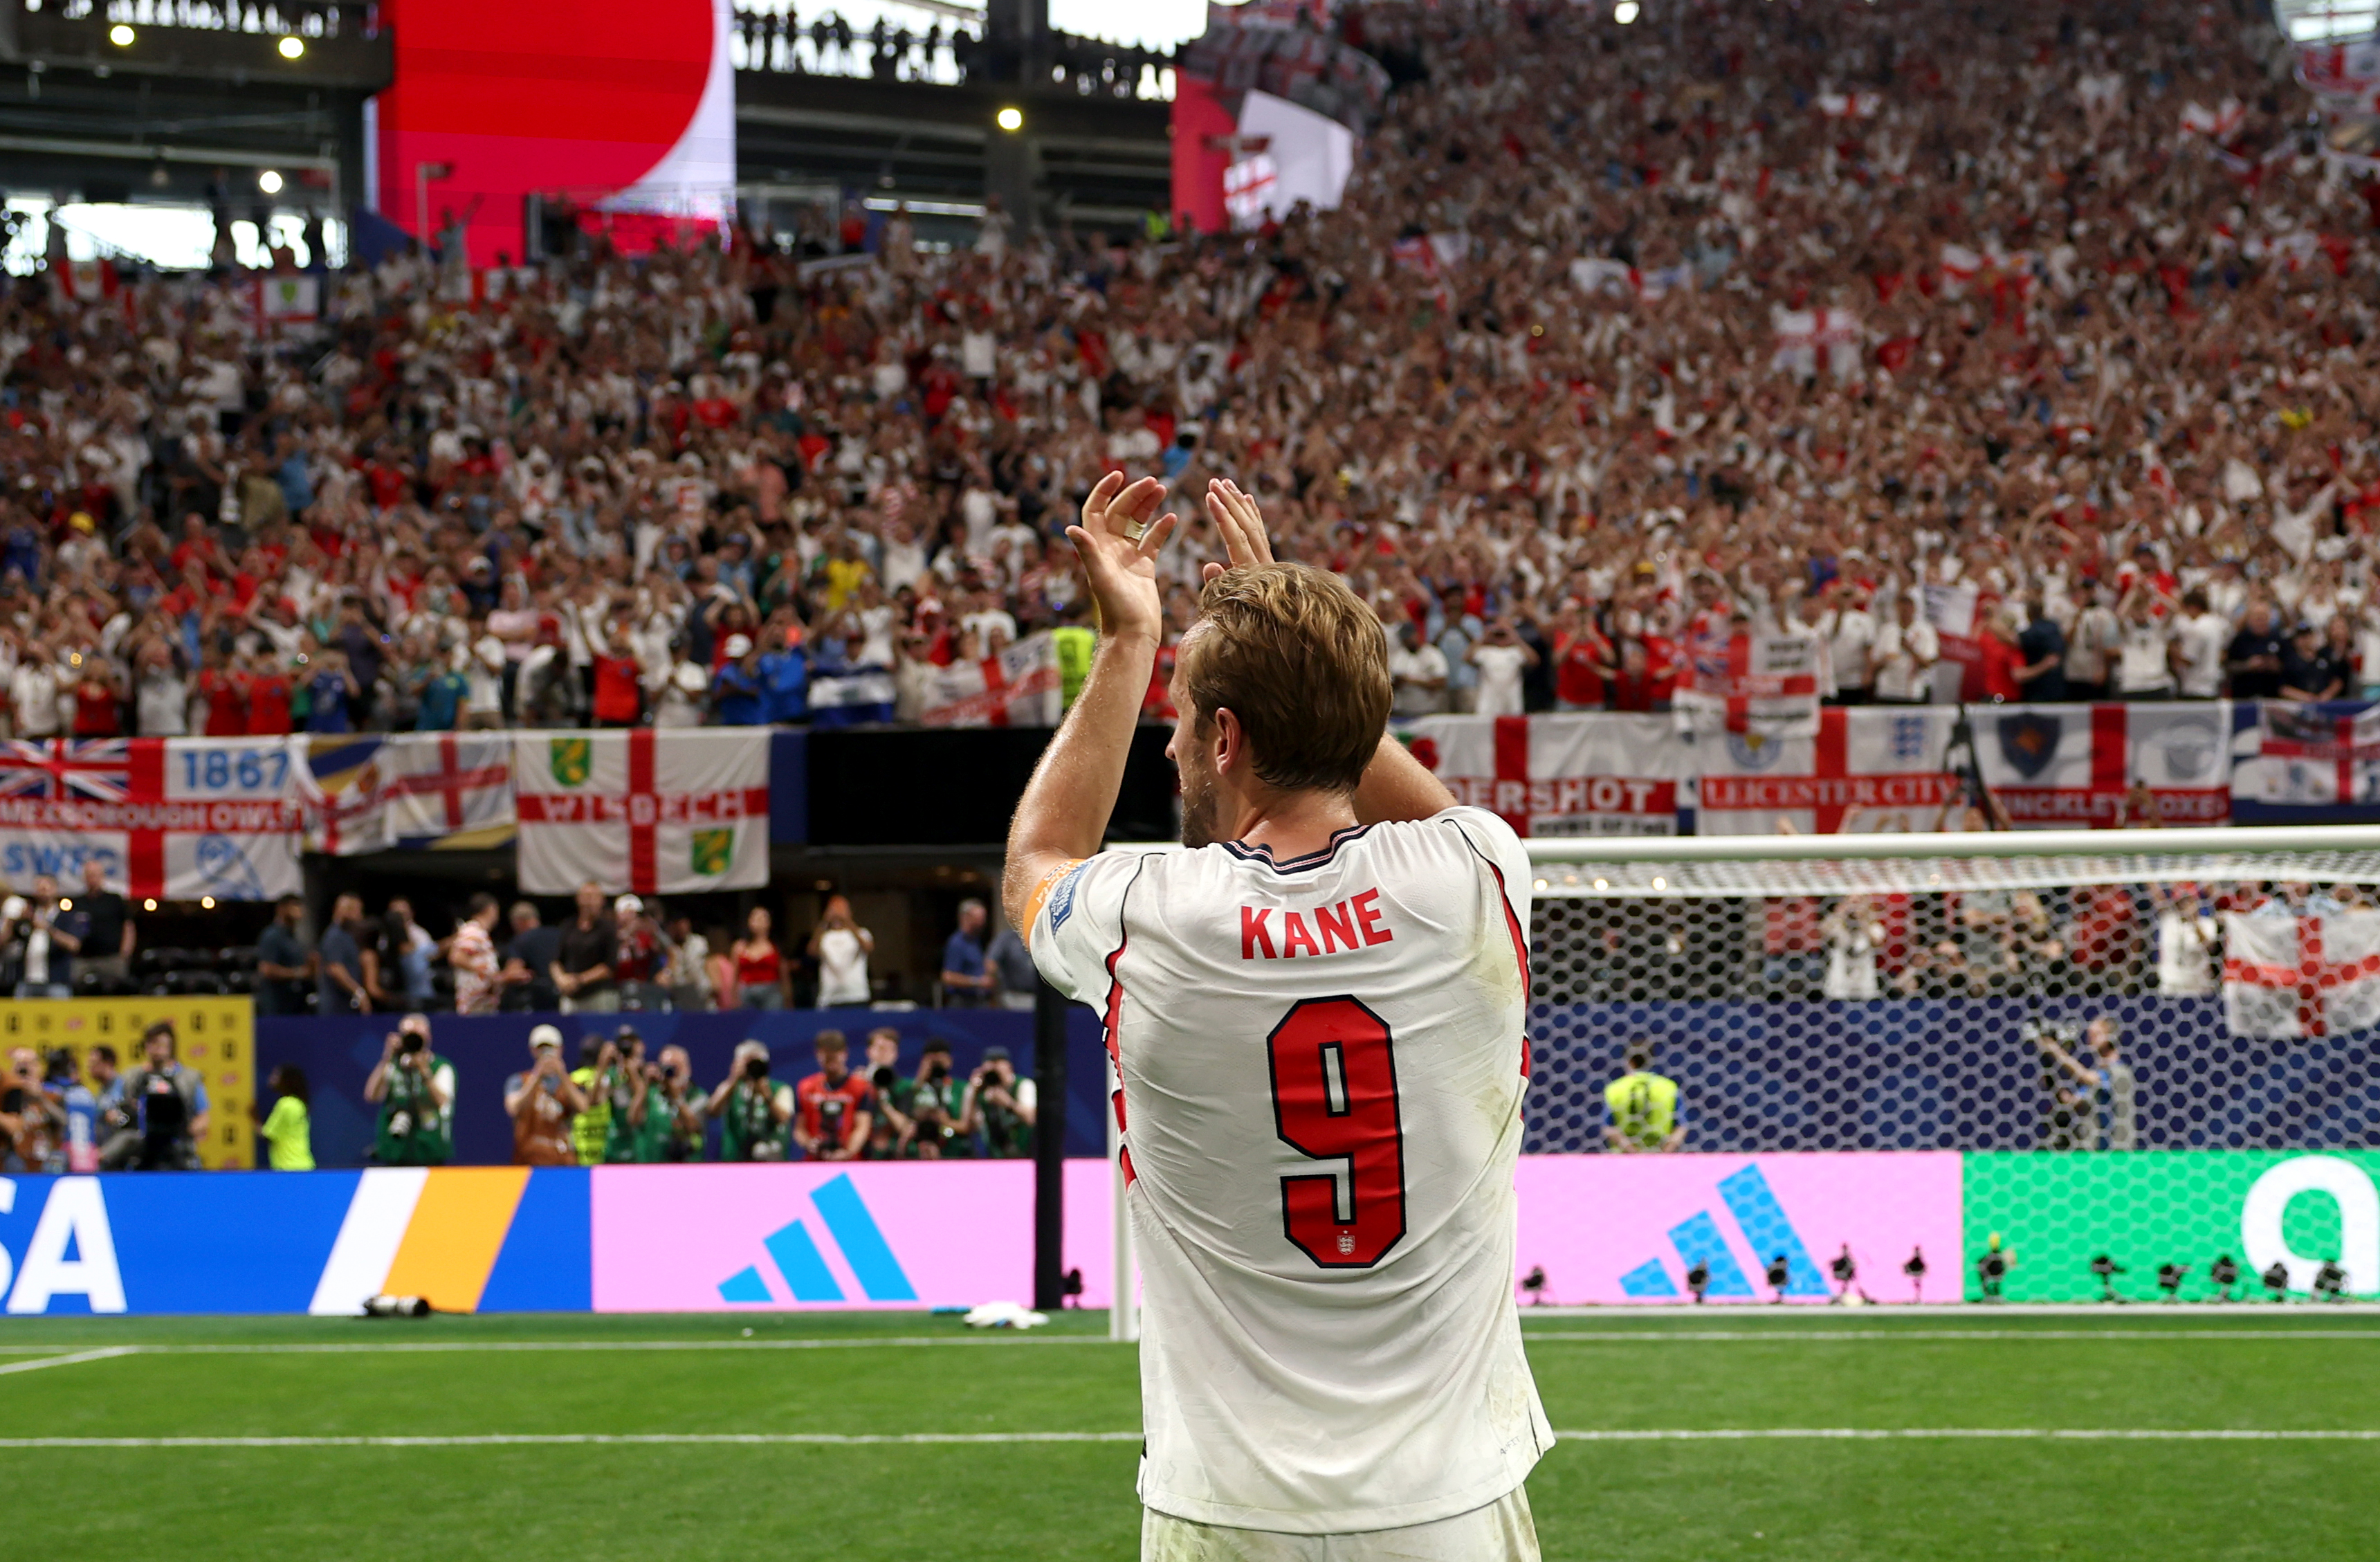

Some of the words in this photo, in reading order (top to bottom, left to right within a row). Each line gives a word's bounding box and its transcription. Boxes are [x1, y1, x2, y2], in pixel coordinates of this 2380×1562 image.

[183, 749, 289, 789] 1867
[1242, 887, 1393, 959] KANE
[1267, 994, 1407, 1268] 9
[0, 1175, 127, 1314] A
